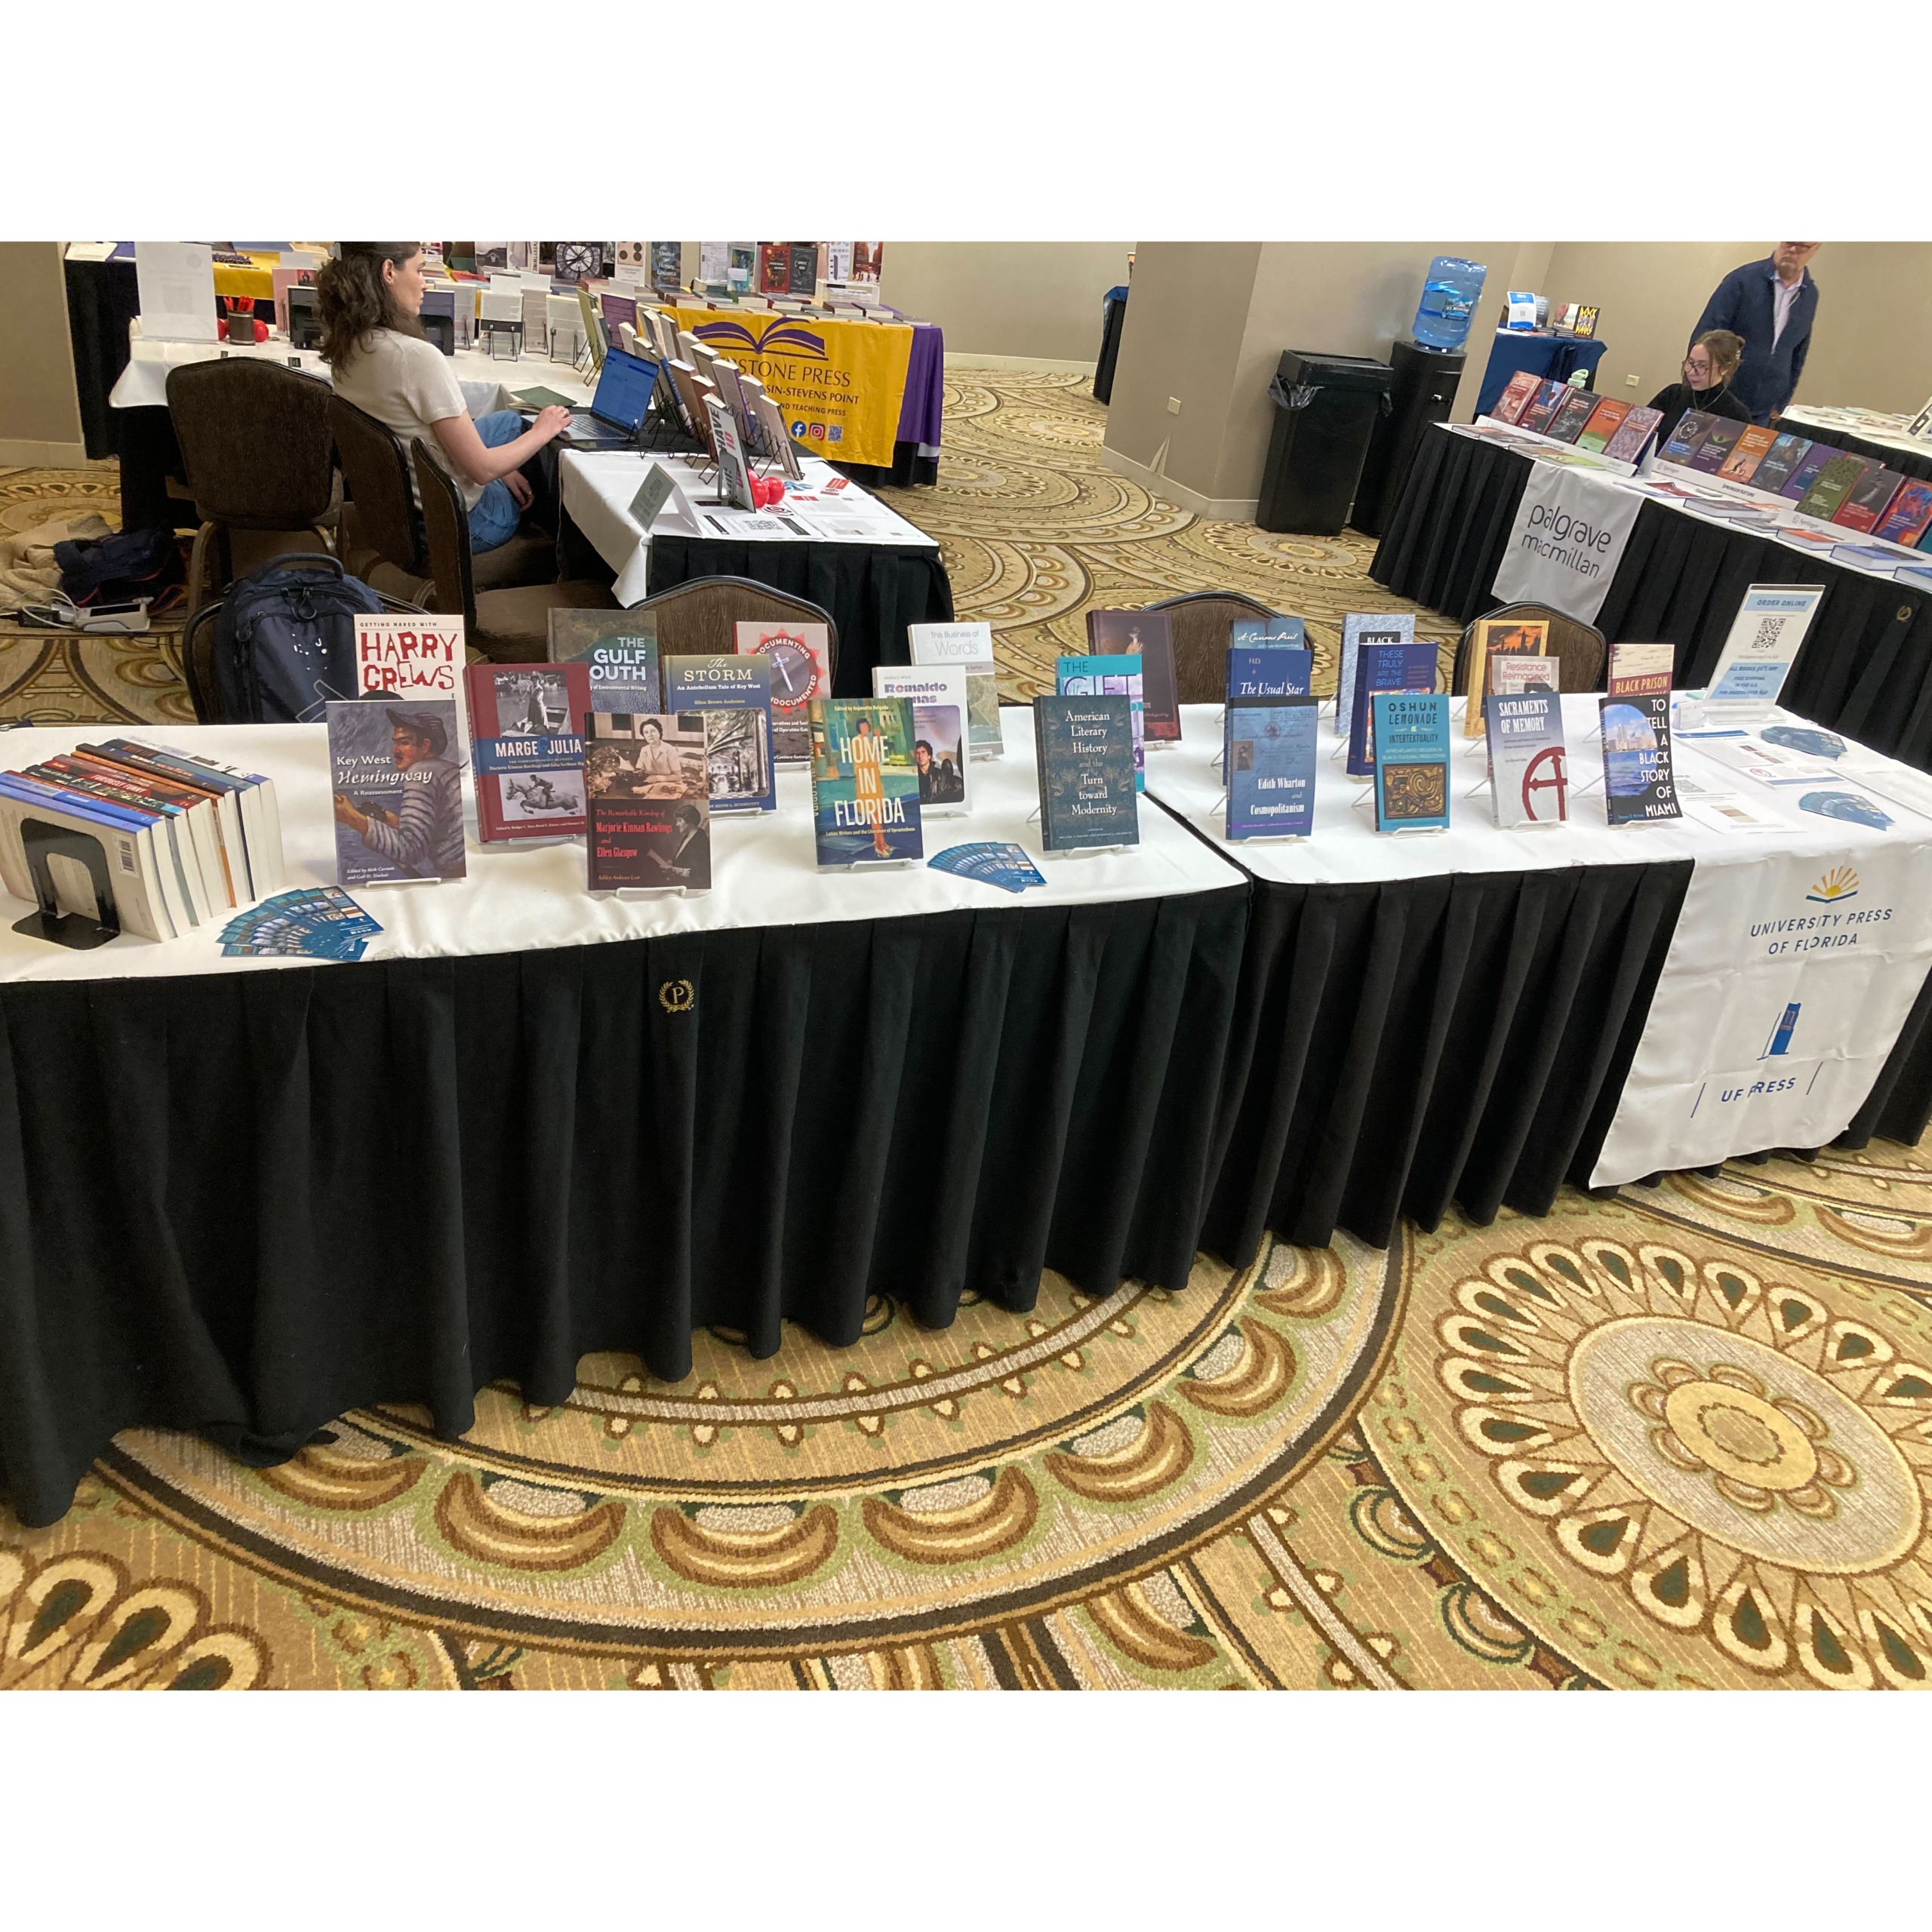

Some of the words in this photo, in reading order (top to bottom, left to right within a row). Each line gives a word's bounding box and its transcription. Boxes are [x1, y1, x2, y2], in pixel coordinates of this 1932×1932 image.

[721, 357, 796, 380] STONE
[802, 366, 851, 387] PRESS
[829, 392, 860, 405] POINT
[792, 404, 826, 414] TEACHING
[711, 407, 726, 451] HAVE
[724, 431, 736, 451] ID
[1663, 465, 1679, 474] Springer
[1722, 483, 1740, 494] SPRINGER
[1740, 489, 1755, 498] NATURE
[1527, 505, 1611, 553] palgrave
[1799, 518, 1820, 529] Springer
[1521, 534, 1600, 578] macmillan
[617, 637, 645, 648] THE
[1238, 632, 1249, 641] A
[1249, 632, 1277, 643] Curious
[1277, 632, 1298, 641] Peril
[361, 632, 457, 662] HARRY
[935, 640, 979, 656] Words
[594, 649, 646, 664] GULF
[1378, 650, 1404, 658] THESE
[707, 658, 729, 669] The
[1063, 661, 1089, 673] THE
[1377, 660, 1404, 668] TRULY
[1506, 663, 1547, 671] Resistance
[364, 661, 454, 691] CREWS
[589, 665, 646, 681] OUTH
[684, 669, 753, 682] STORM
[1503, 672, 1550, 683] Reimagined
[884, 682, 947, 694] Reinaldo
[1064, 674, 1137, 696] GIFT
[1240, 682, 1257, 694] The
[1259, 681, 1284, 694] Usual
[1285, 683, 1305, 695] Star
[1376, 678, 1402, 686] BRAVE
[1616, 679, 1639, 694] BLACK
[1641, 676, 1668, 691] PRISON
[771, 675, 817, 706] NDOCUMENTED
[1388, 703, 1437, 712] OSHUN
[1499, 700, 1549, 716] SACRAMENTS
[1651, 699, 1666, 712] TO
[1065, 710, 1110, 721] American
[1389, 713, 1438, 724] LEMONADE
[1500, 719, 1510, 734] OF
[1513, 717, 1545, 732] MEMORY
[1646, 717, 1667, 729] TELL
[1071, 725, 1107, 738] Literary
[1389, 734, 1438, 743] INTERTEXTUALITY
[1660, 734, 1668, 746] A
[495, 741, 539, 758] MARGE
[548, 739, 583, 755] JULIA
[840, 736, 891, 764] HOME
[1073, 742, 1108, 755] History
[337, 756, 358, 768] Key
[361, 755, 392, 765] West
[1079, 758, 1091, 768] and
[1093, 758, 1103, 767] the
[1638, 752, 1669, 764] BLACK
[337, 770, 433, 786] Hemingway
[858, 768, 877, 794] IN
[1081, 774, 1103, 785] Turn
[1641, 769, 1669, 783] STORY
[91, 774, 125, 787] FURIOUSLY
[123, 782, 147, 793] FUNNY
[1258, 778, 1276, 790] Edith
[1278, 778, 1306, 789] Wharton
[1078, 786, 1108, 800] toward
[1656, 786, 1672, 798] OF
[638, 809, 659, 817] Kinship
[834, 798, 906, 826] FLORIDA
[1072, 802, 1117, 816] Modernity
[1251, 802, 1305, 817] Cosmopolitanism
[1645, 803, 1677, 817] MIAMI
[596, 822, 622, 834] Marjorie
[623, 822, 645, 832] Kinnan
[646, 822, 672, 834] Rawlings
[597, 847, 612, 857] Ellen
[613, 847, 638, 859] Glasgow
[1751, 915, 1842, 937] UNIVERSITY
[1846, 909, 1893, 925] PRESS
[1768, 941, 1789, 955] OF
[1795, 933, 1858, 952] FLORIDA
[672, 986, 685, 1004] P
[1721, 1088, 1744, 1102] UF
[1747, 1077, 1796, 1098] PRESS
